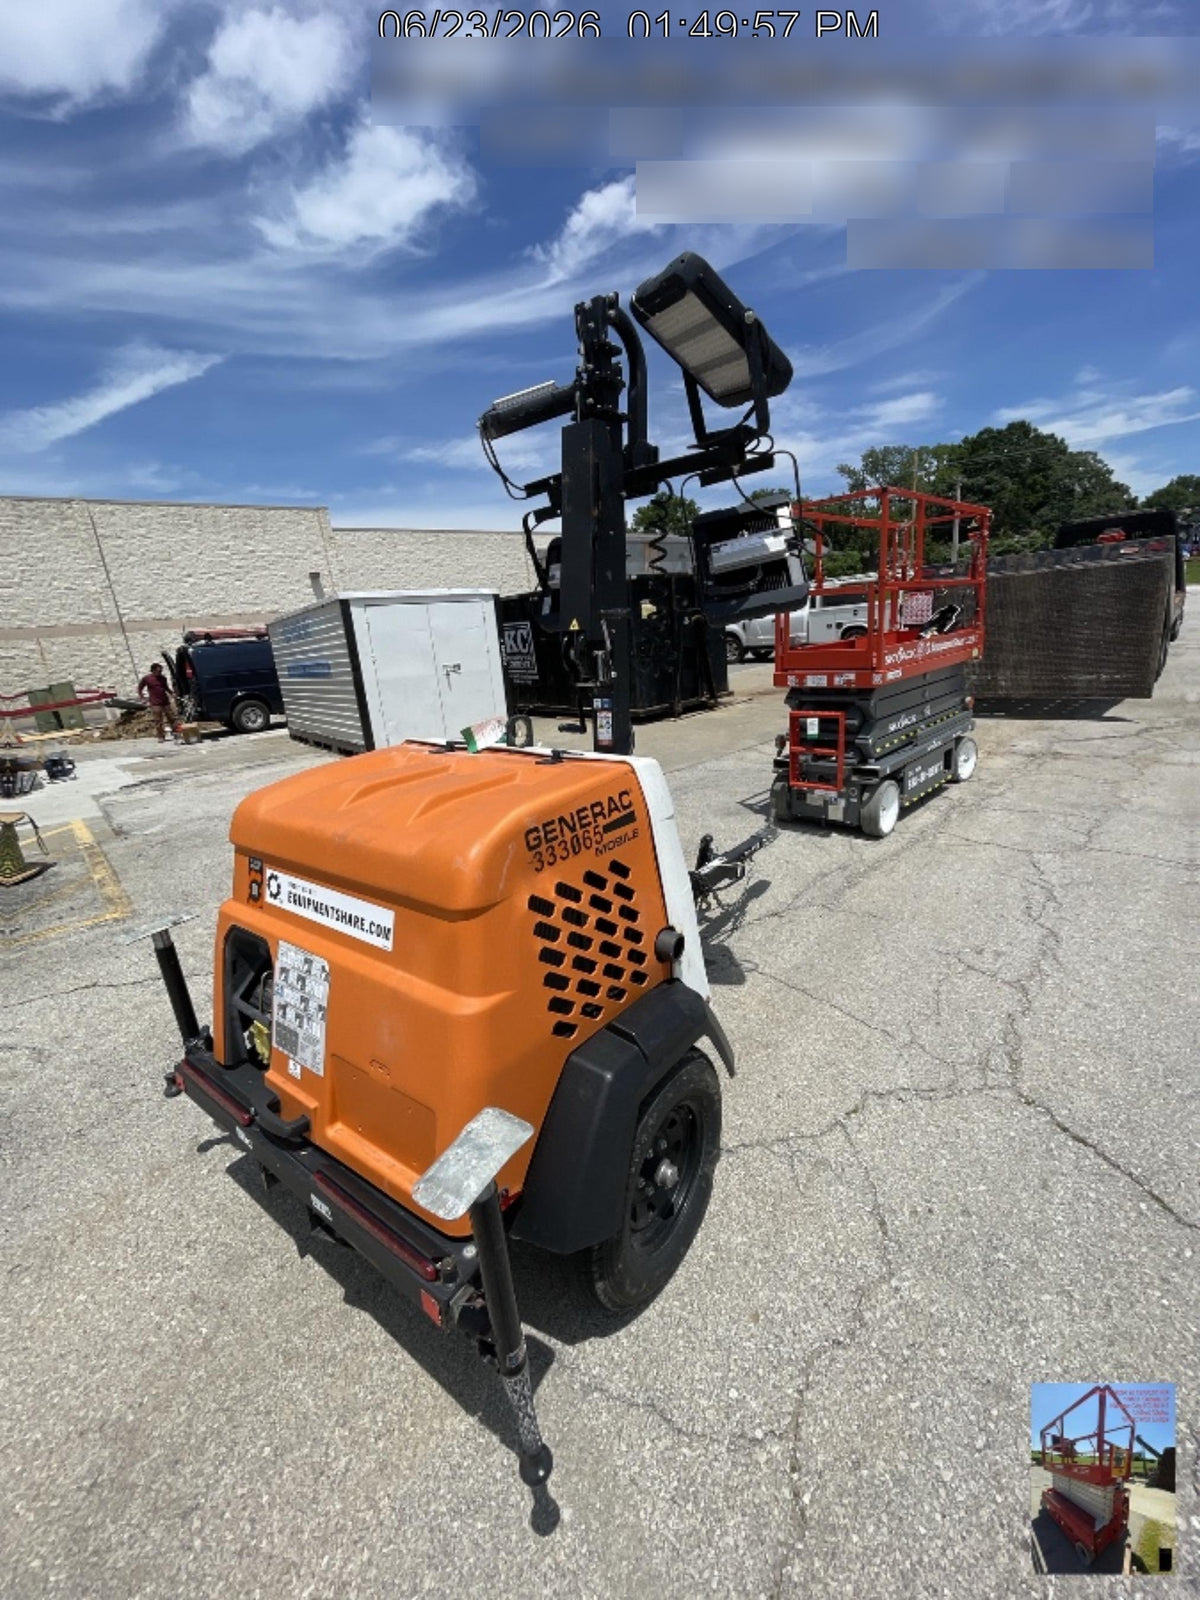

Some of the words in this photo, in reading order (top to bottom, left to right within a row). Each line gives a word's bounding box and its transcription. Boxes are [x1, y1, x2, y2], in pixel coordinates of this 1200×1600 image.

[504, 629, 530, 653] KC
[524, 789, 633, 852] GENERAC
[594, 828, 639, 857] MOBILE
[532, 824, 604, 873] 333065
[287, 890, 392, 941] EQUIPMENTSHARE.COM
